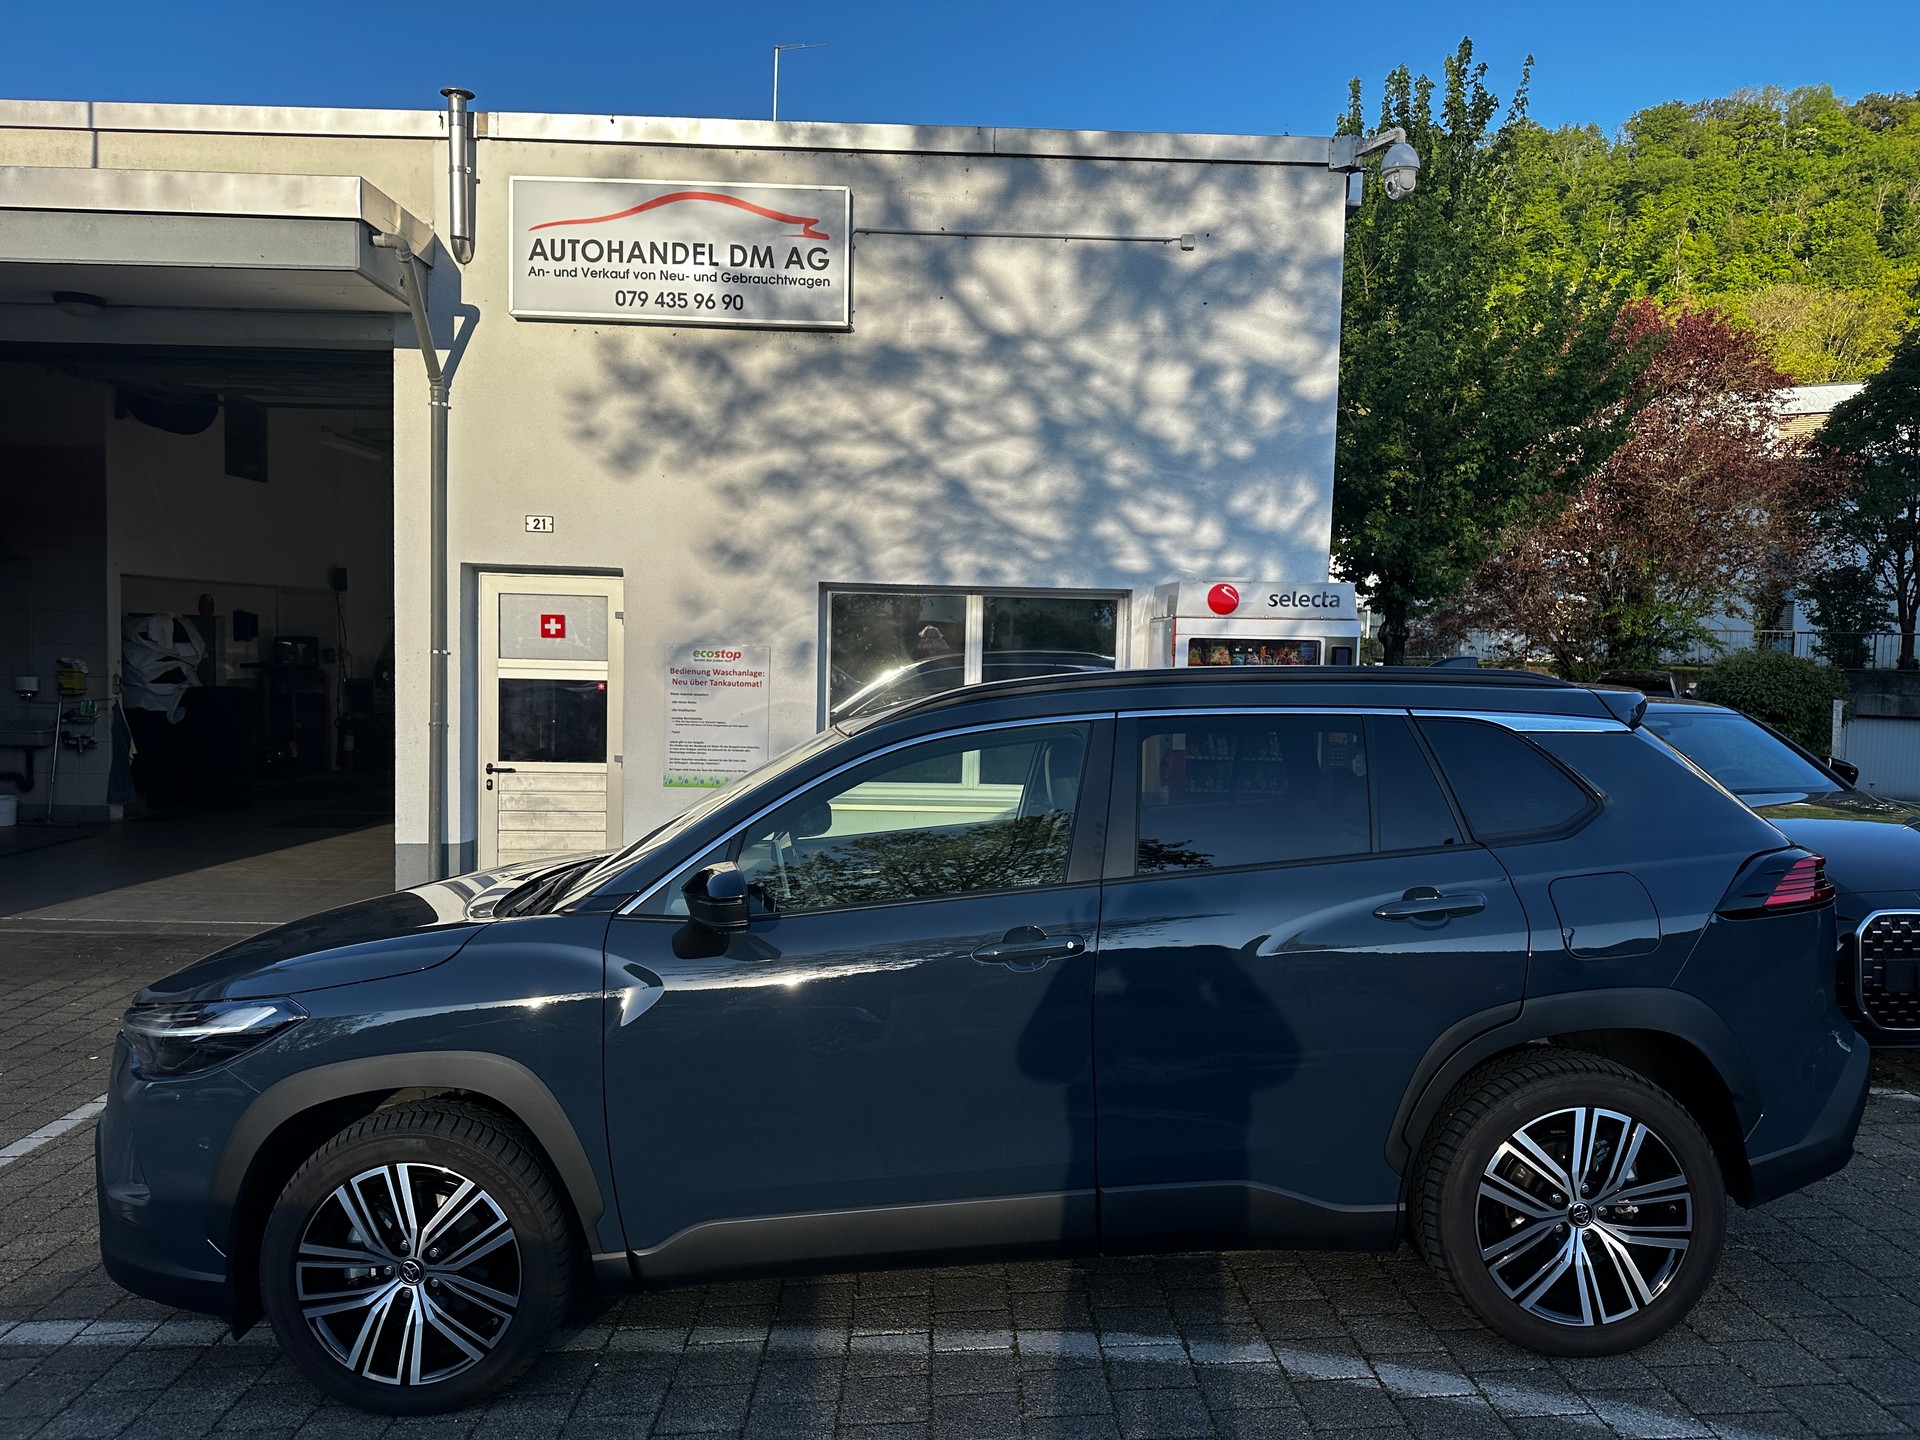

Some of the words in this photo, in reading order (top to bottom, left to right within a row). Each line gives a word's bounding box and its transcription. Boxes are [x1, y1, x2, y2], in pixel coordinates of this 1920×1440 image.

[528, 238, 720, 266] AUTOHANDEL
[729, 244, 775, 269] DM
[784, 246, 830, 271] AG
[528, 266, 550, 278] An-
[554, 267, 578, 278] und
[581, 267, 630, 280] Verkauf
[633, 271, 656, 280] von
[660, 270, 690, 281] Neu-
[693, 272, 717, 283] und
[721, 272, 831, 289] Gebrauchtwagen
[615, 290, 649, 308] 079
[654, 291, 688, 309] 435
[693, 293, 716, 310] 96
[721, 294, 744, 311] 90
[533, 518, 546, 530] 21
[1267, 591, 1341, 608] selecta
[692, 649, 742, 661] ecostop
[669, 667, 711, 676] Bedienung
[712, 668, 765, 678] Waschanlage:
[672, 678, 688, 686] Neu
[690, 678, 708, 686] über
[709, 679, 763, 688] Tankautomat!
